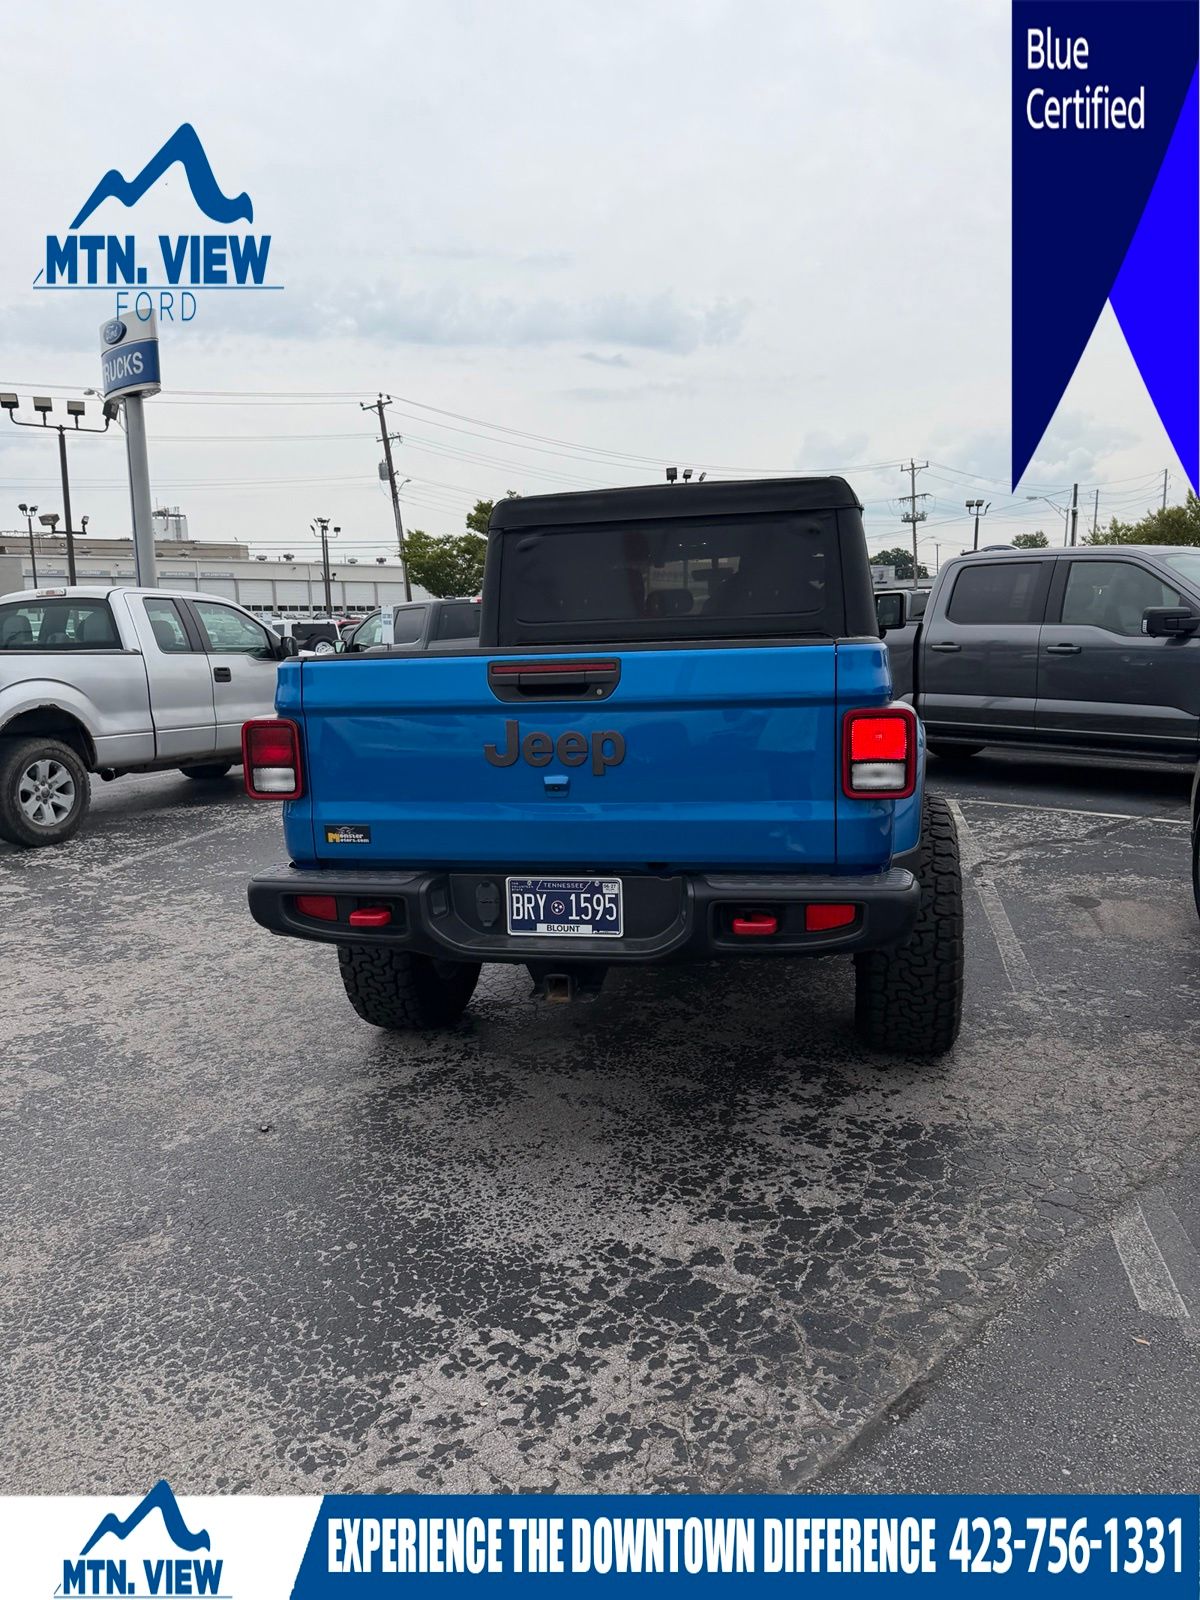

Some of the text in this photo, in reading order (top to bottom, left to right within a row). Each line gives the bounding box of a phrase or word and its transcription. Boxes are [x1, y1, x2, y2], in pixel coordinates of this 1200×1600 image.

[103, 351, 144, 384] RUCKS
[484, 719, 625, 776] Jeep
[511, 893, 617, 921] BRY 1595
[546, 924, 580, 932] BLOUNT
